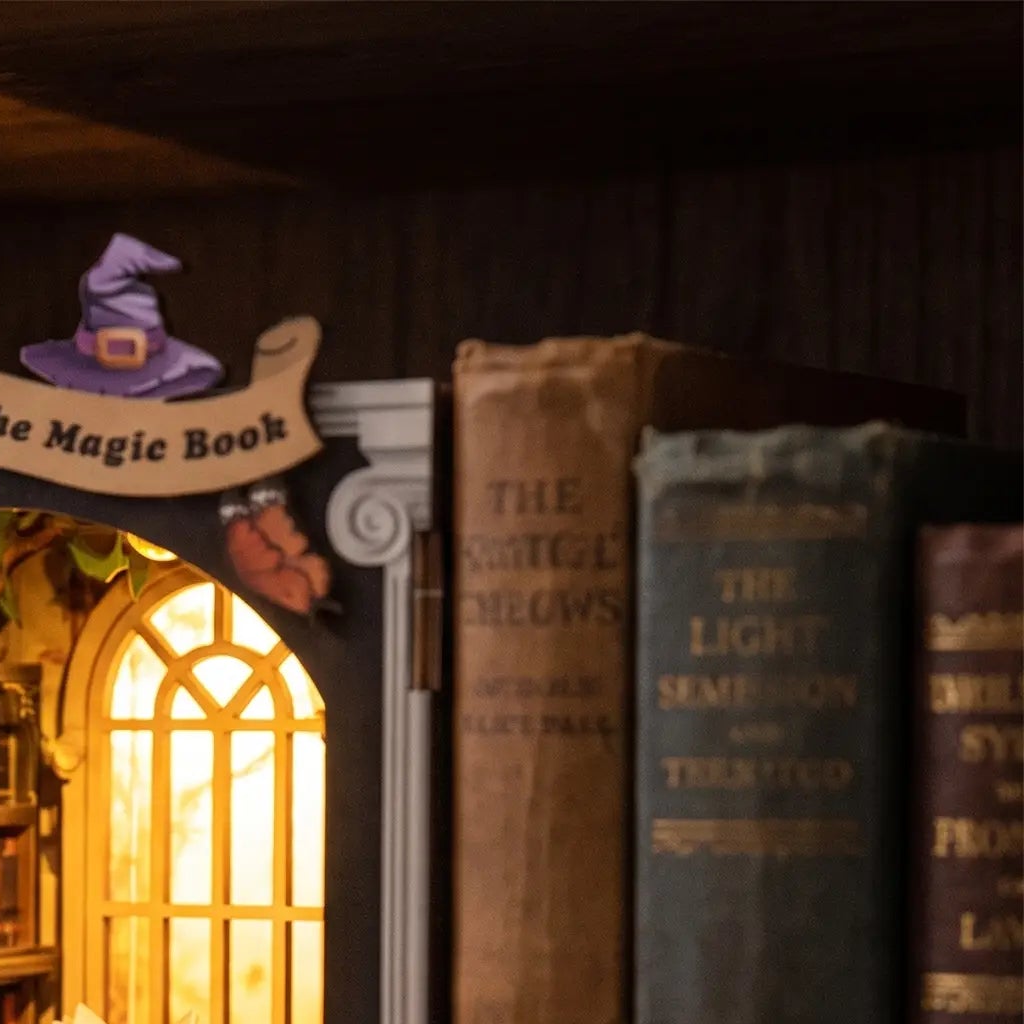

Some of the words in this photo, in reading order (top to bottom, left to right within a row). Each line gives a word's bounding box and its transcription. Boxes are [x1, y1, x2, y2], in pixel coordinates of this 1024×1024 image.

[42, 419, 167, 467] Magic
[184, 412, 288, 460] Book
[488, 478, 583, 515] THE
